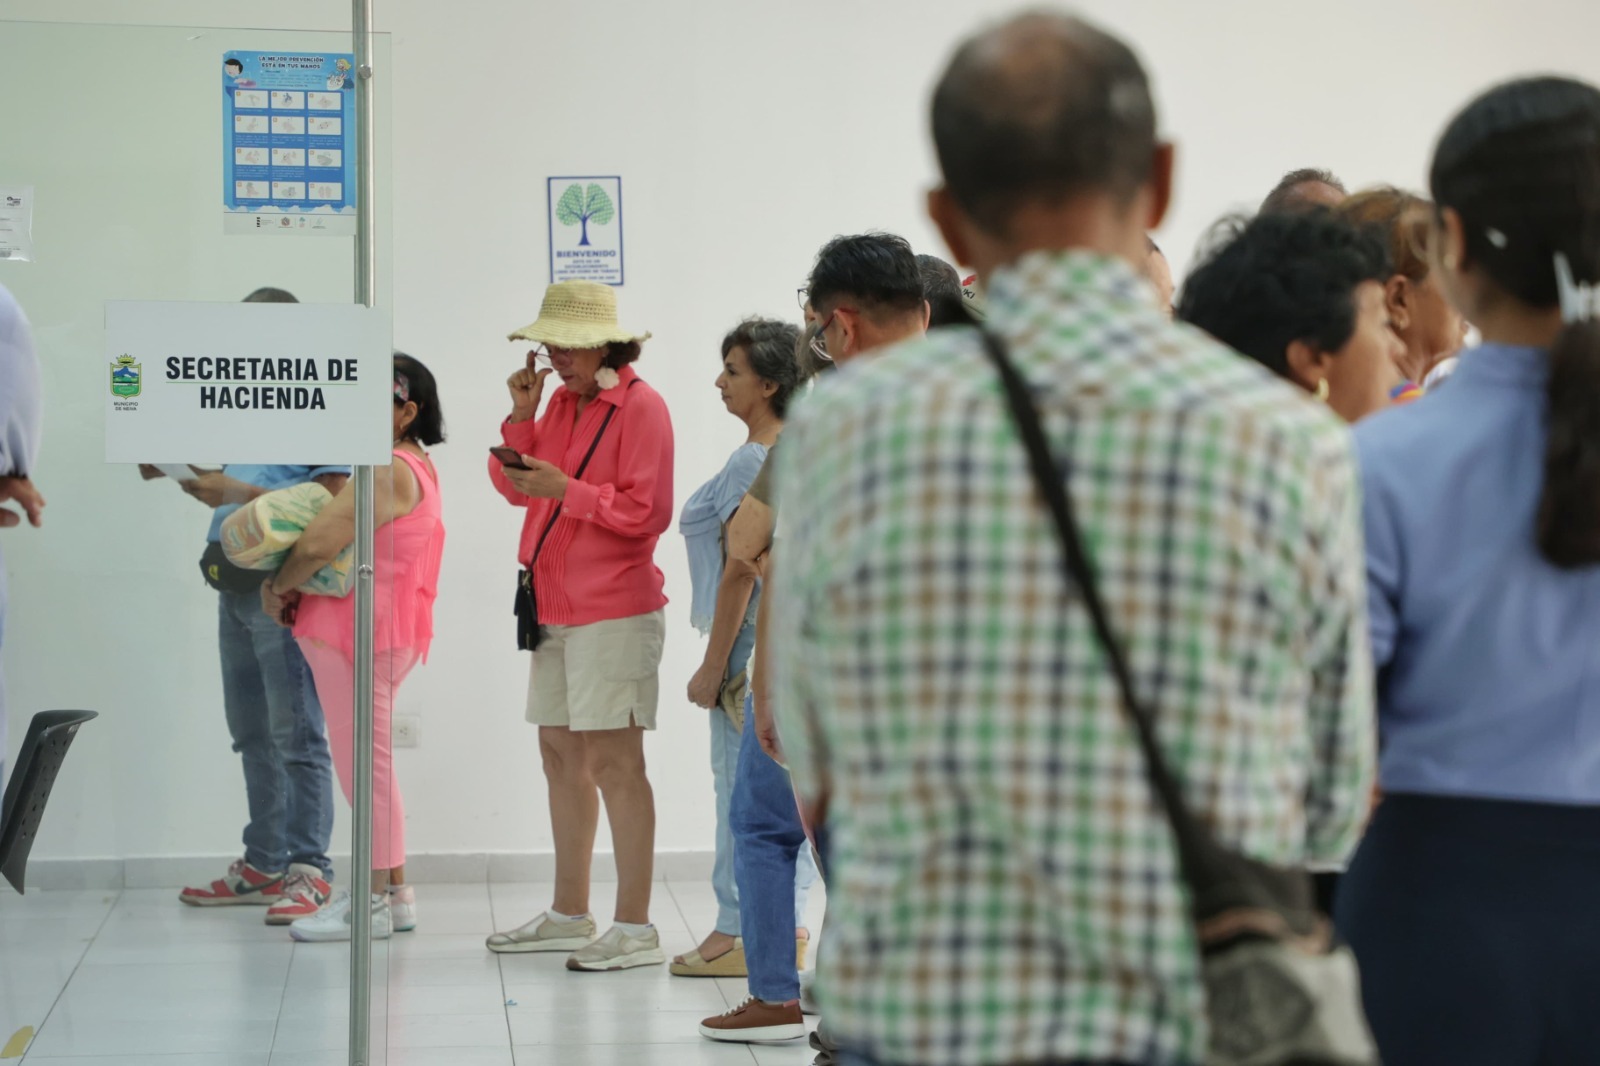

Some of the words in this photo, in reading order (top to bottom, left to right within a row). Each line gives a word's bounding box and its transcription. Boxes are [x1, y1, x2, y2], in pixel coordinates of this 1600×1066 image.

[556, 250, 616, 258] BIENVENIDO
[165, 356, 319, 381] SECRETARIA
[327, 358, 358, 381] DE
[200, 386, 326, 410] HACIENDA
